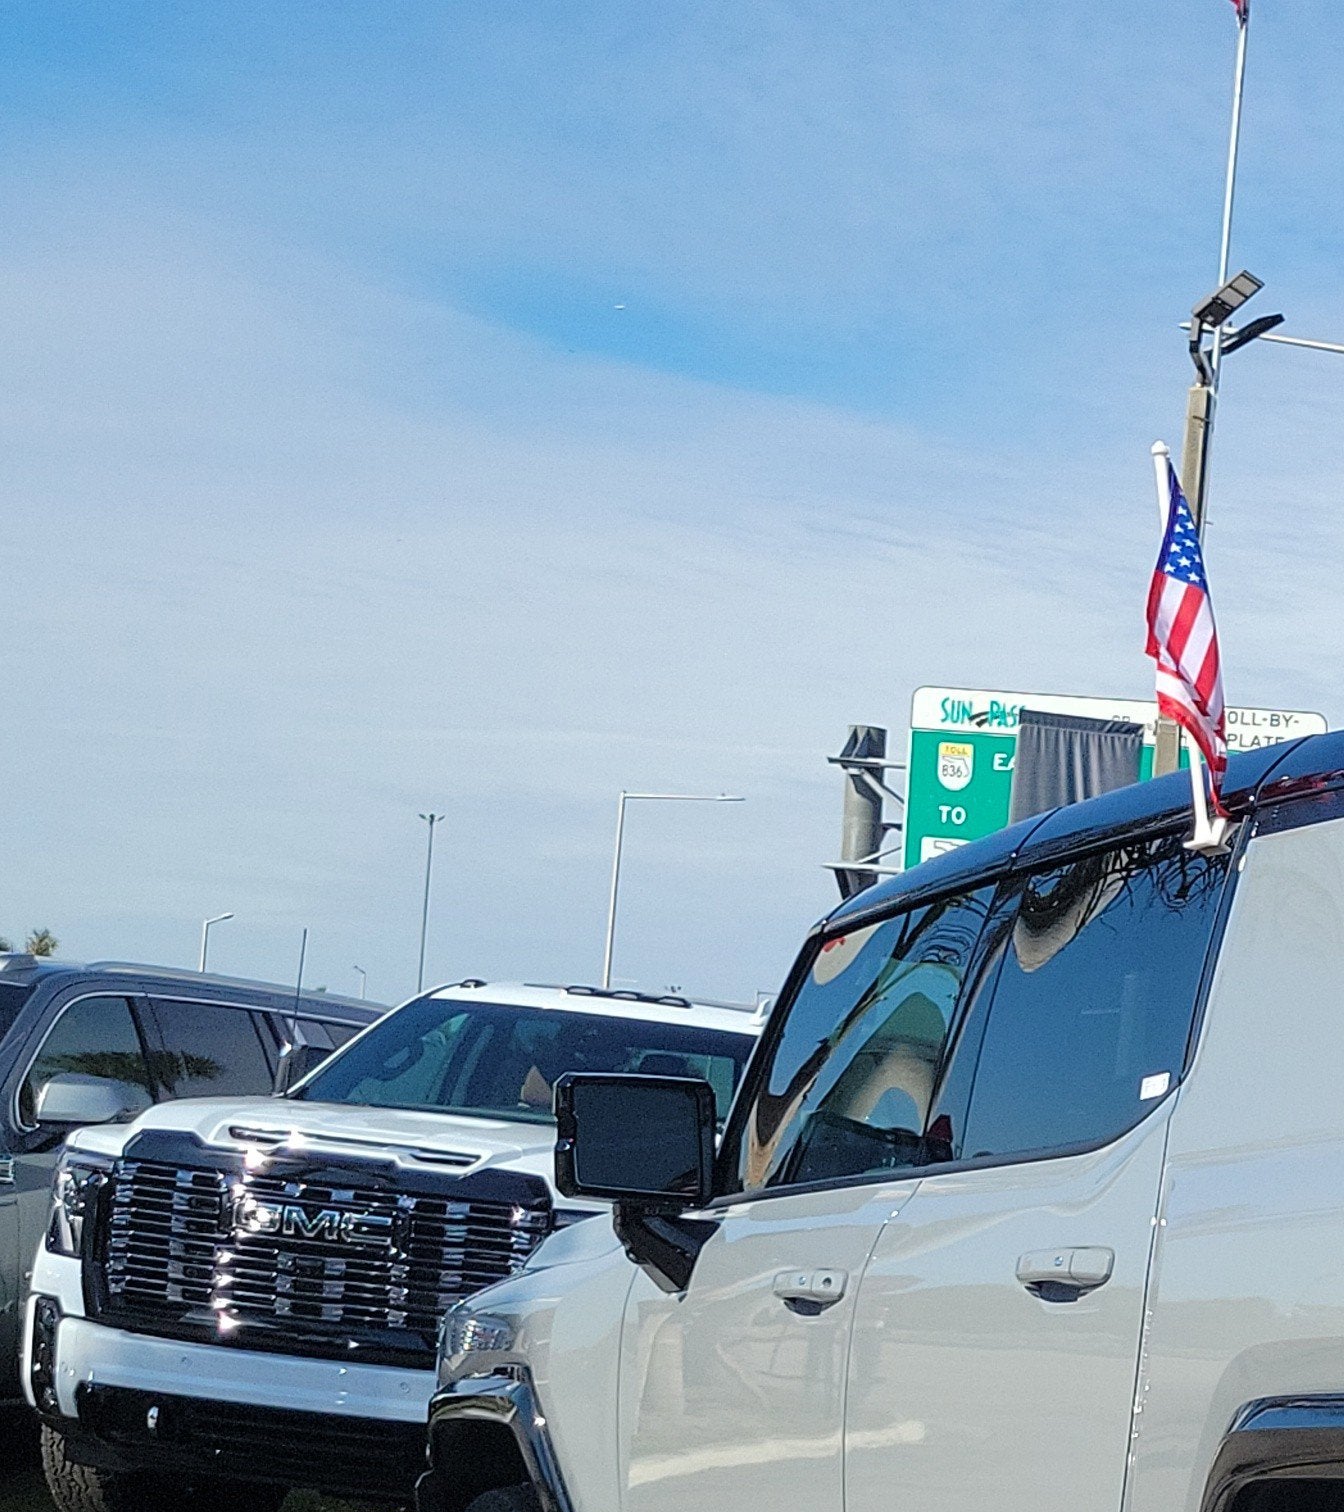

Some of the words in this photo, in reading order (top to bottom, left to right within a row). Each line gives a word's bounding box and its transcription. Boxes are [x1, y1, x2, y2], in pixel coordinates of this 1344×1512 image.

[1227, 710, 1300, 728] OLL-BY-
[942, 764, 963, 778] 836
[938, 805, 967, 825] TO
[232, 1202, 393, 1245] GMC
